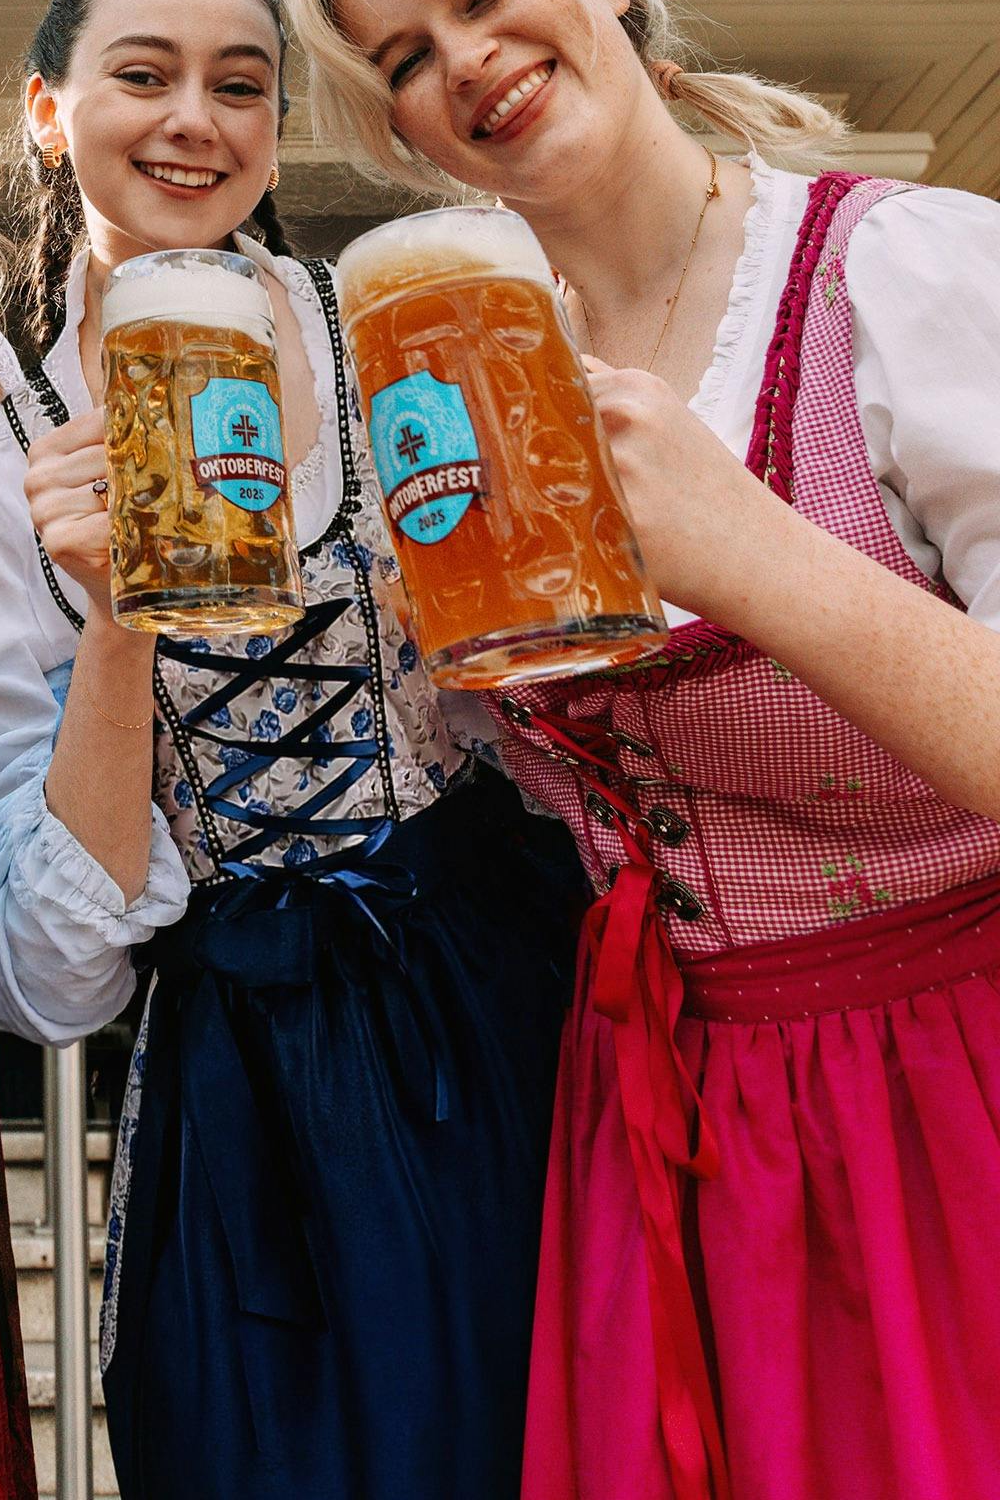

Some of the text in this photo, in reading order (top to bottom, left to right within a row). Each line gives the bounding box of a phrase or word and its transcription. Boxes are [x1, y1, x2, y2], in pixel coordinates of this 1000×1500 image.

[199, 458, 285, 485] OKTOBERFEST
[239, 487, 265, 500] 2025
[389, 466, 482, 521] OKTOBERFEST
[418, 509, 446, 532] 2025
